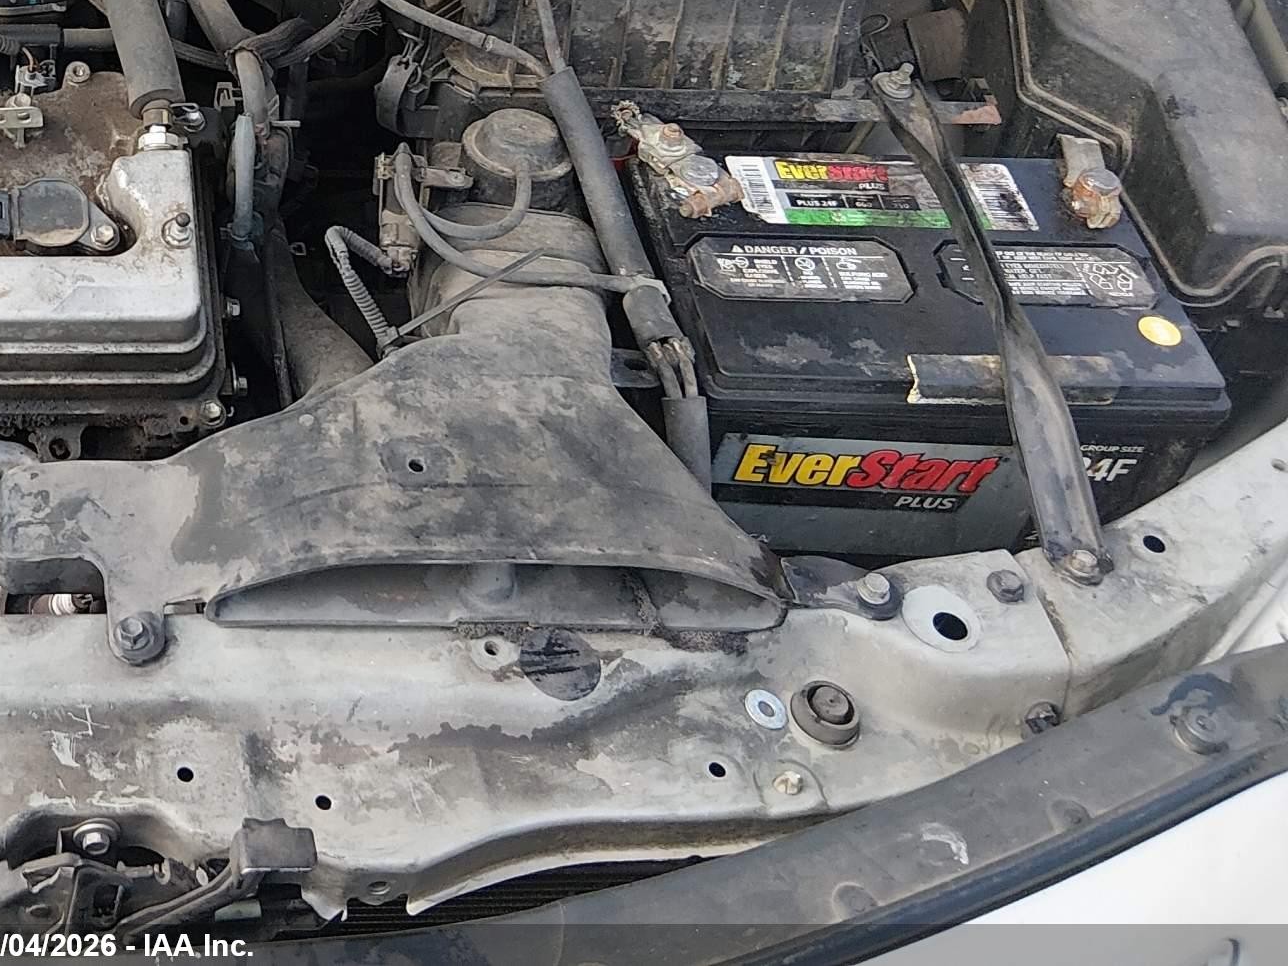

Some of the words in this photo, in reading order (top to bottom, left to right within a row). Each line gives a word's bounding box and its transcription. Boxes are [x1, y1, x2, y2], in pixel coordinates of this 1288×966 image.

[775, 161, 889, 182] EverStart
[858, 182, 886, 191] PLUS
[744, 245, 798, 255] DANGER
[809, 246, 858, 256] POISON
[1080, 444, 1120, 452] GROUP
[733, 443, 1001, 493] EverStart
[895, 496, 958, 510] PLUS
